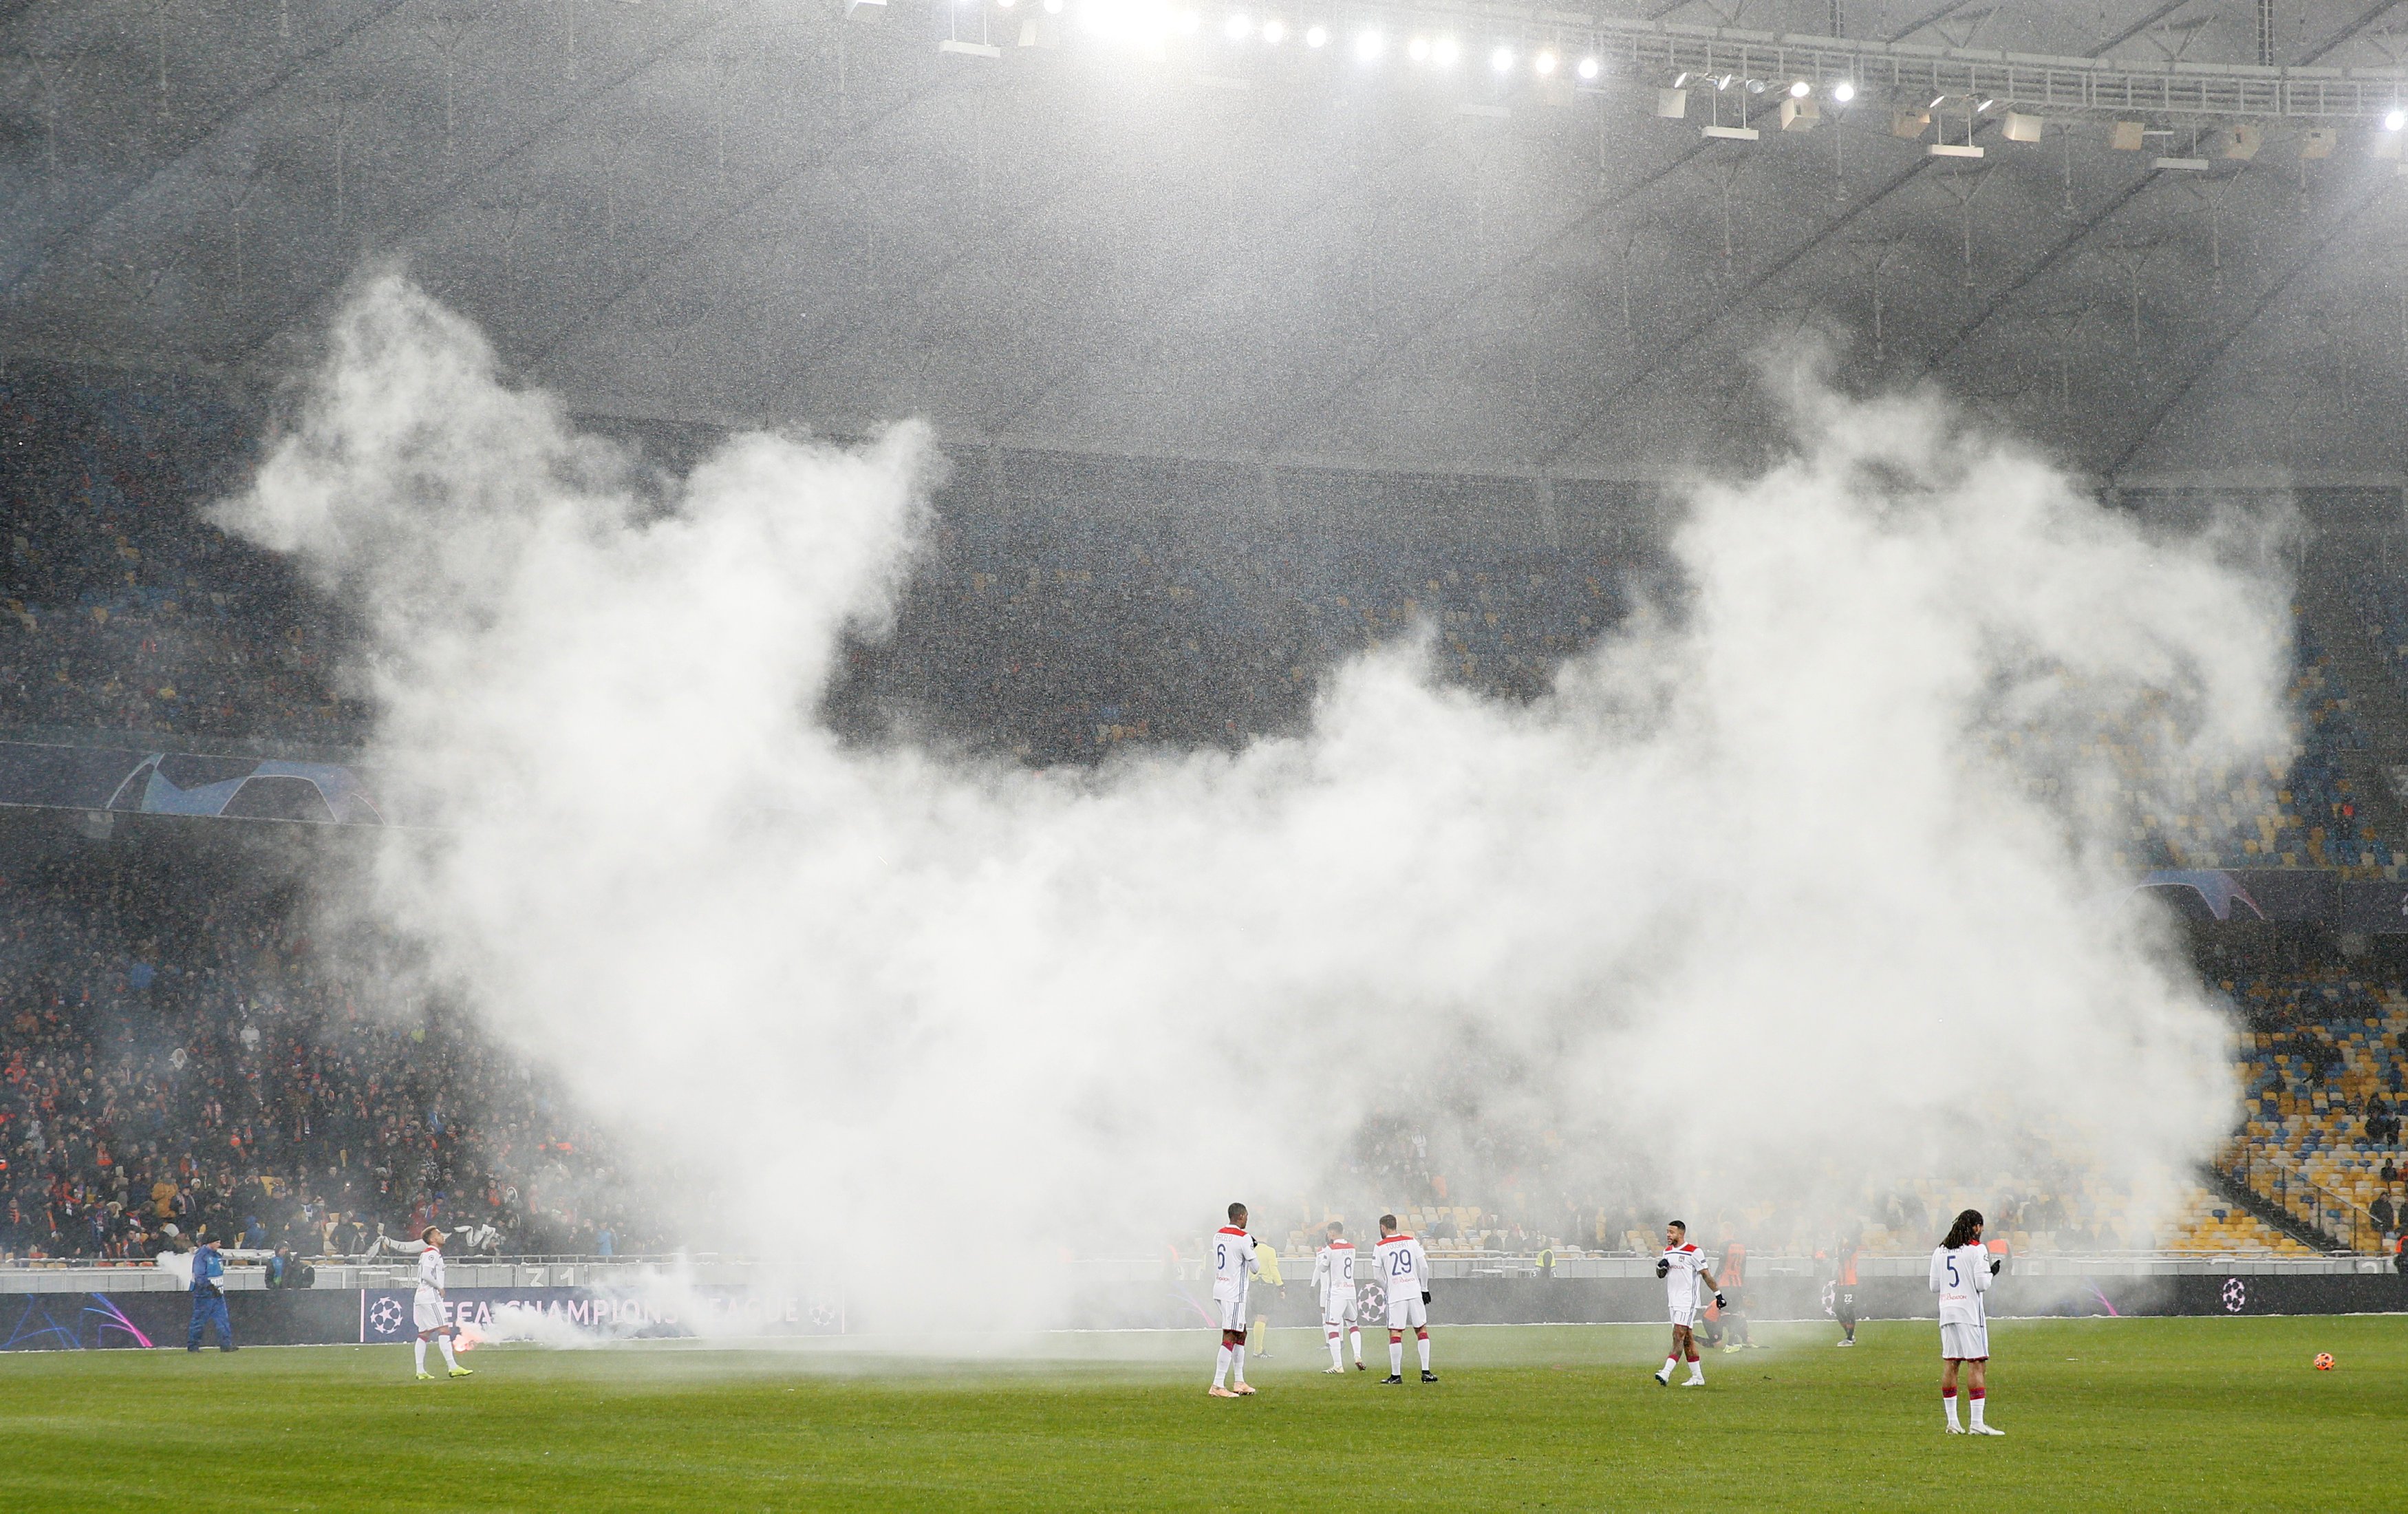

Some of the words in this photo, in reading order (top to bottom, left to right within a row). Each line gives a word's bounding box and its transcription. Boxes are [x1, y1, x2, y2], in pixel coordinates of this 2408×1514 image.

[1217, 1244, 1226, 1270] 6
[1344, 1257, 1352, 1279] 8
[1389, 1249, 1411, 1276] 29
[1946, 1255, 1959, 1288] 5
[1844, 1294, 1853, 1303] 22
[413, 1301, 493, 1328] EFA
